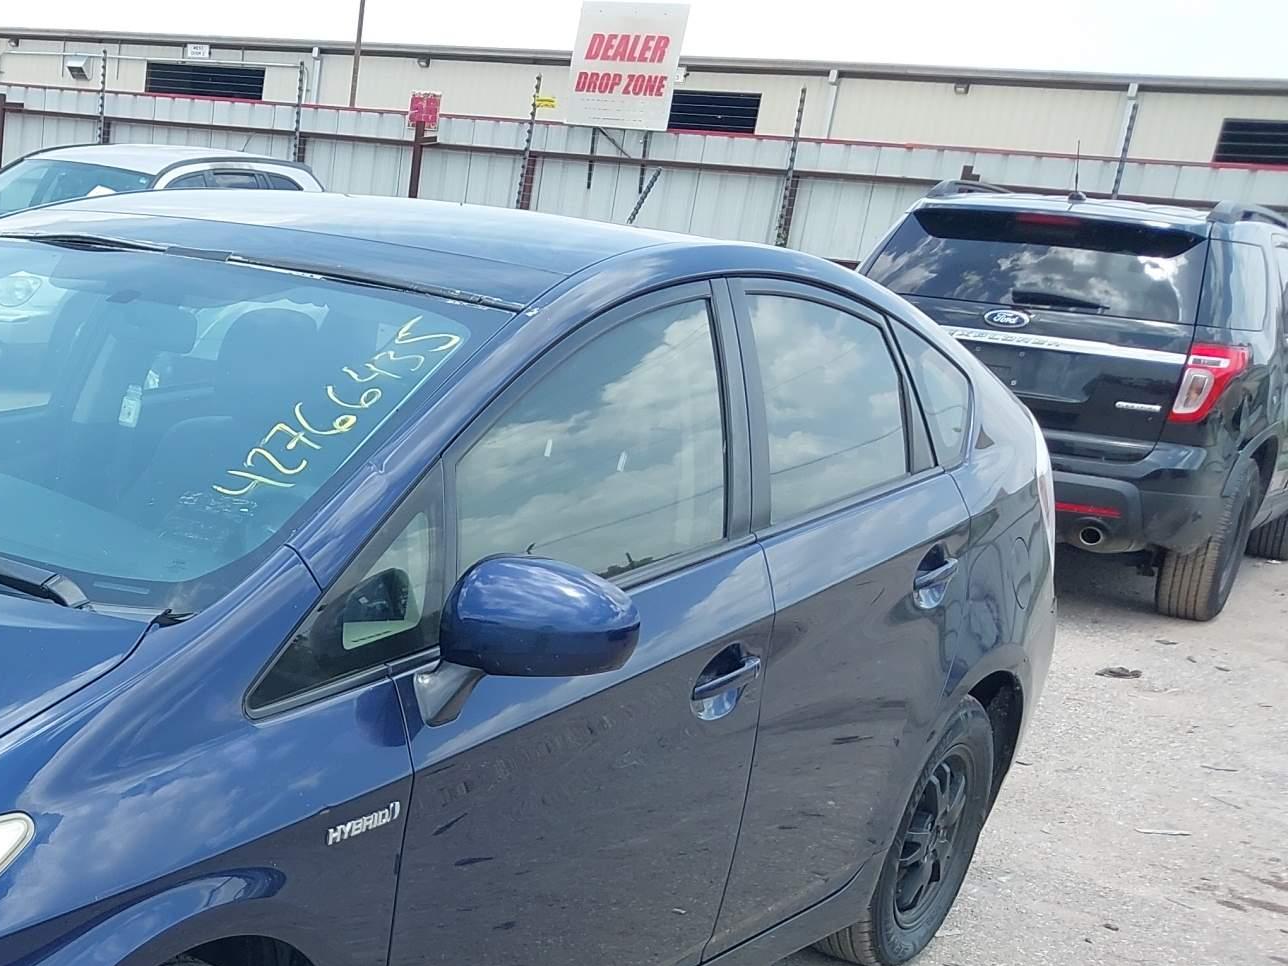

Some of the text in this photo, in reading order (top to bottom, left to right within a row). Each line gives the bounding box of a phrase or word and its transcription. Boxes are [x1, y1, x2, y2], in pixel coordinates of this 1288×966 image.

[584, 33, 670, 64] DEALER
[574, 71, 668, 97] DROP ZONE
[992, 311, 1018, 325] Ford
[212, 315, 461, 496] 42766435
[327, 806, 392, 846] HYBRID
